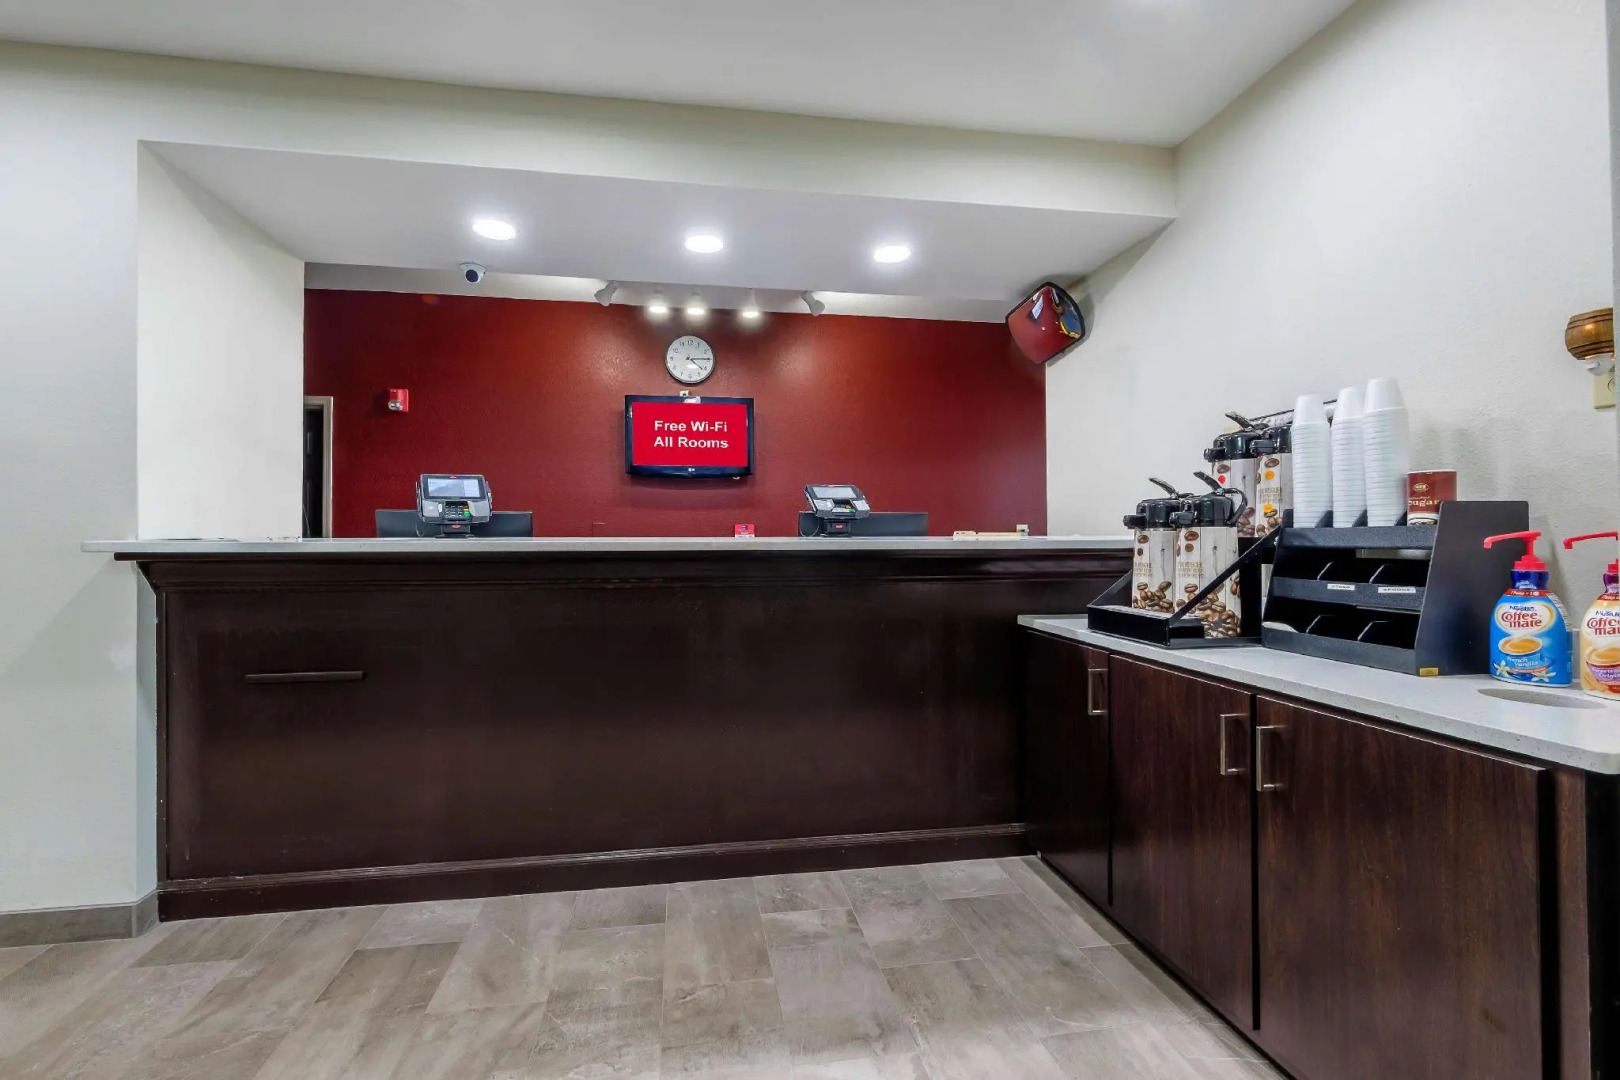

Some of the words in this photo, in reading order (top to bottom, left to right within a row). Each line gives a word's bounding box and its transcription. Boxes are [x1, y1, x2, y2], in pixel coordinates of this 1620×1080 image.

[654, 420, 687, 432] Free
[690, 420, 728, 432] Wi-Fi
[654, 436, 673, 448] All
[678, 436, 729, 448] Rooms
[1501, 612, 1538, 622] Coffee
[1509, 620, 1542, 628] mate
